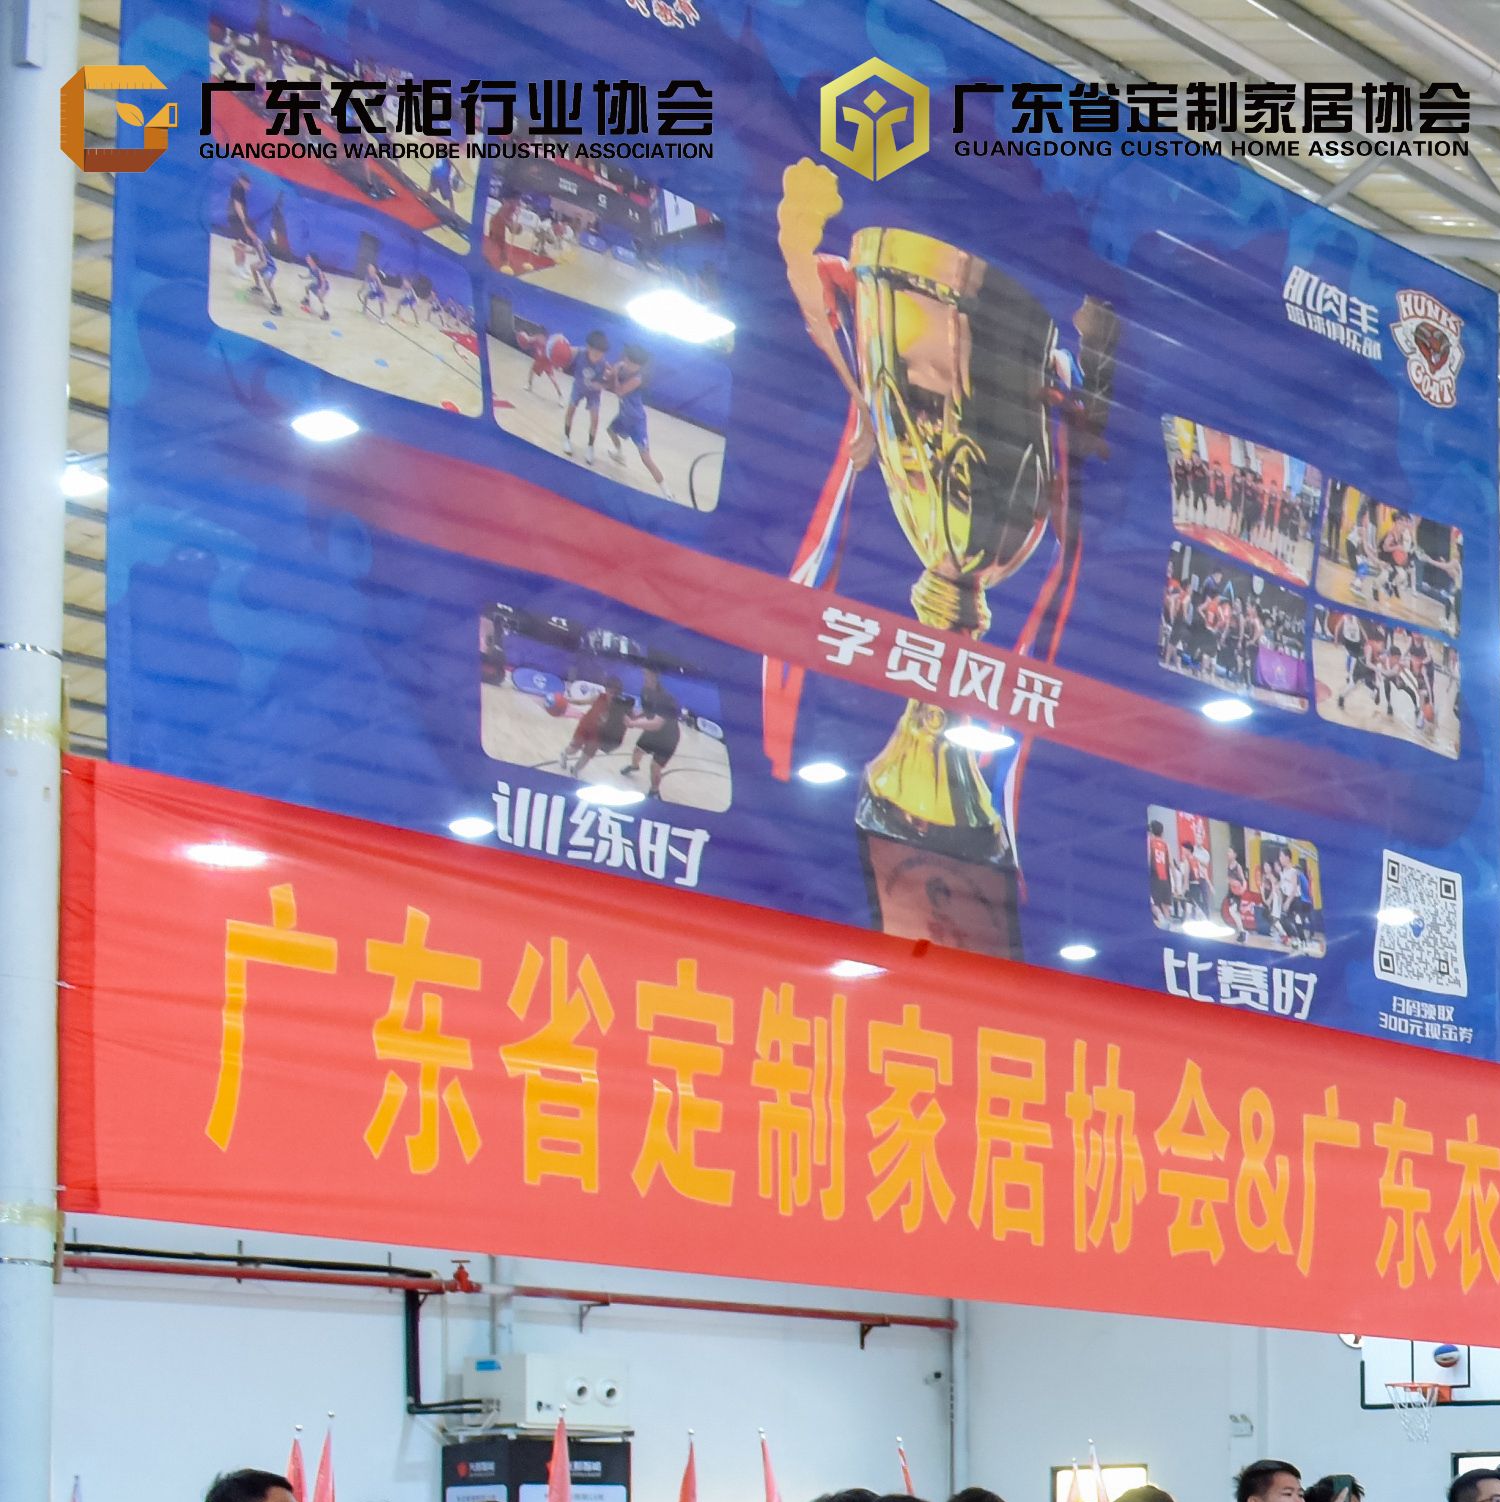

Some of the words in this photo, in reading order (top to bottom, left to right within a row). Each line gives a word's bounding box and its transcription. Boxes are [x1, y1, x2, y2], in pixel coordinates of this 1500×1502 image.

[1409, 360, 1455, 404] GOAT
[817, 607, 1063, 728] 学员风采
[492, 781, 711, 888] 训练时
[1163, 947, 1318, 1020] 比赛时
[1392, 995, 1455, 1022] 扫码领取
[1378, 1011, 1473, 1044] 300元现金券
